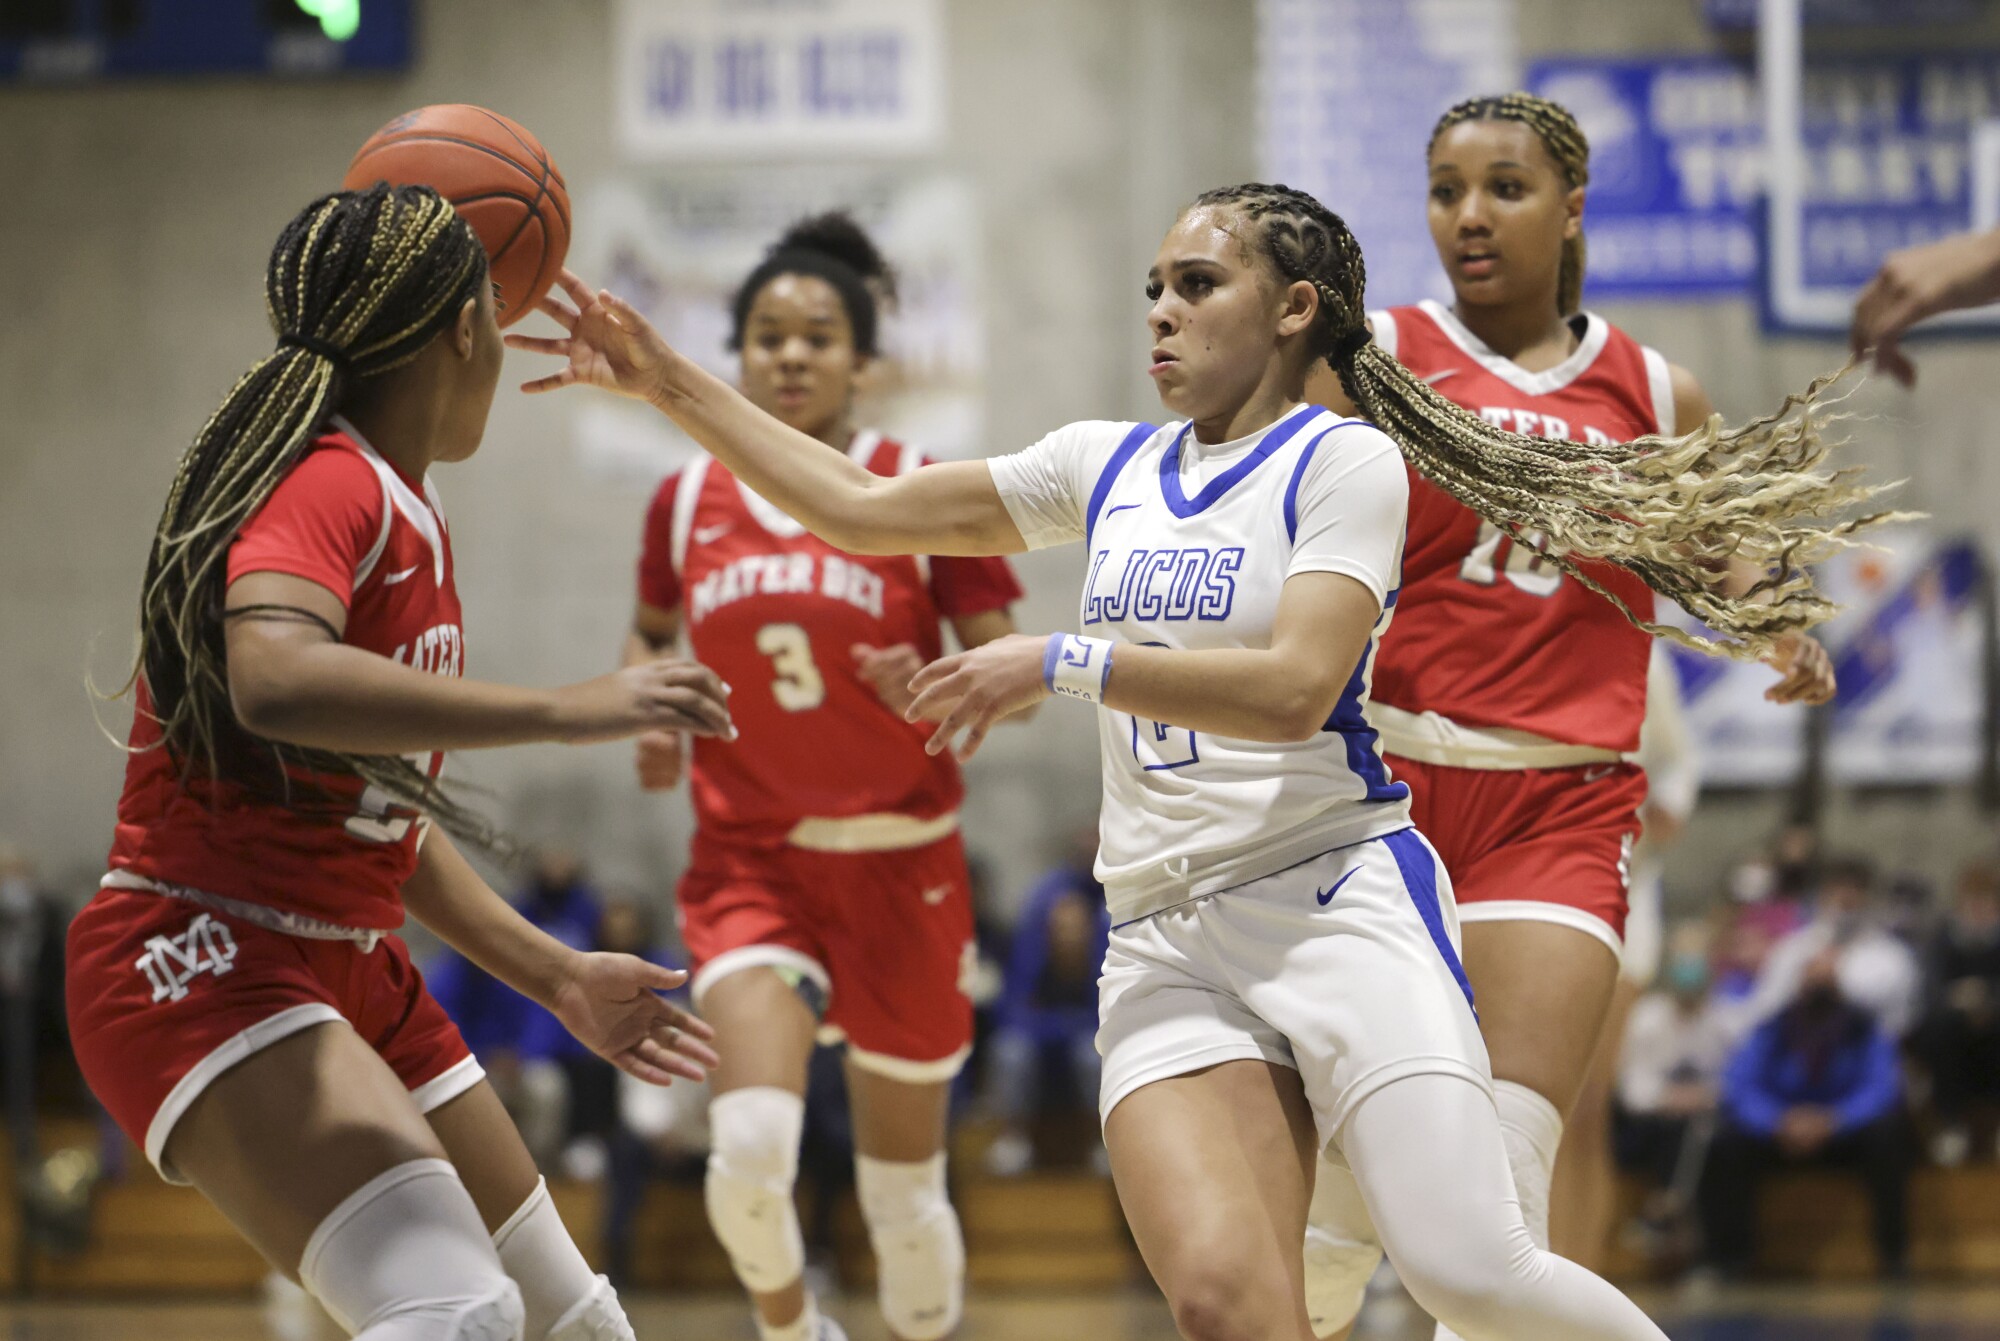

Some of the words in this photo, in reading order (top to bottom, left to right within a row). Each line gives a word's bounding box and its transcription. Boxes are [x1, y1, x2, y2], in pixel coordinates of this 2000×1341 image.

[691, 552, 815, 623] MATER
[1084, 547, 1246, 625] LJCDS
[755, 622, 826, 713] 3
